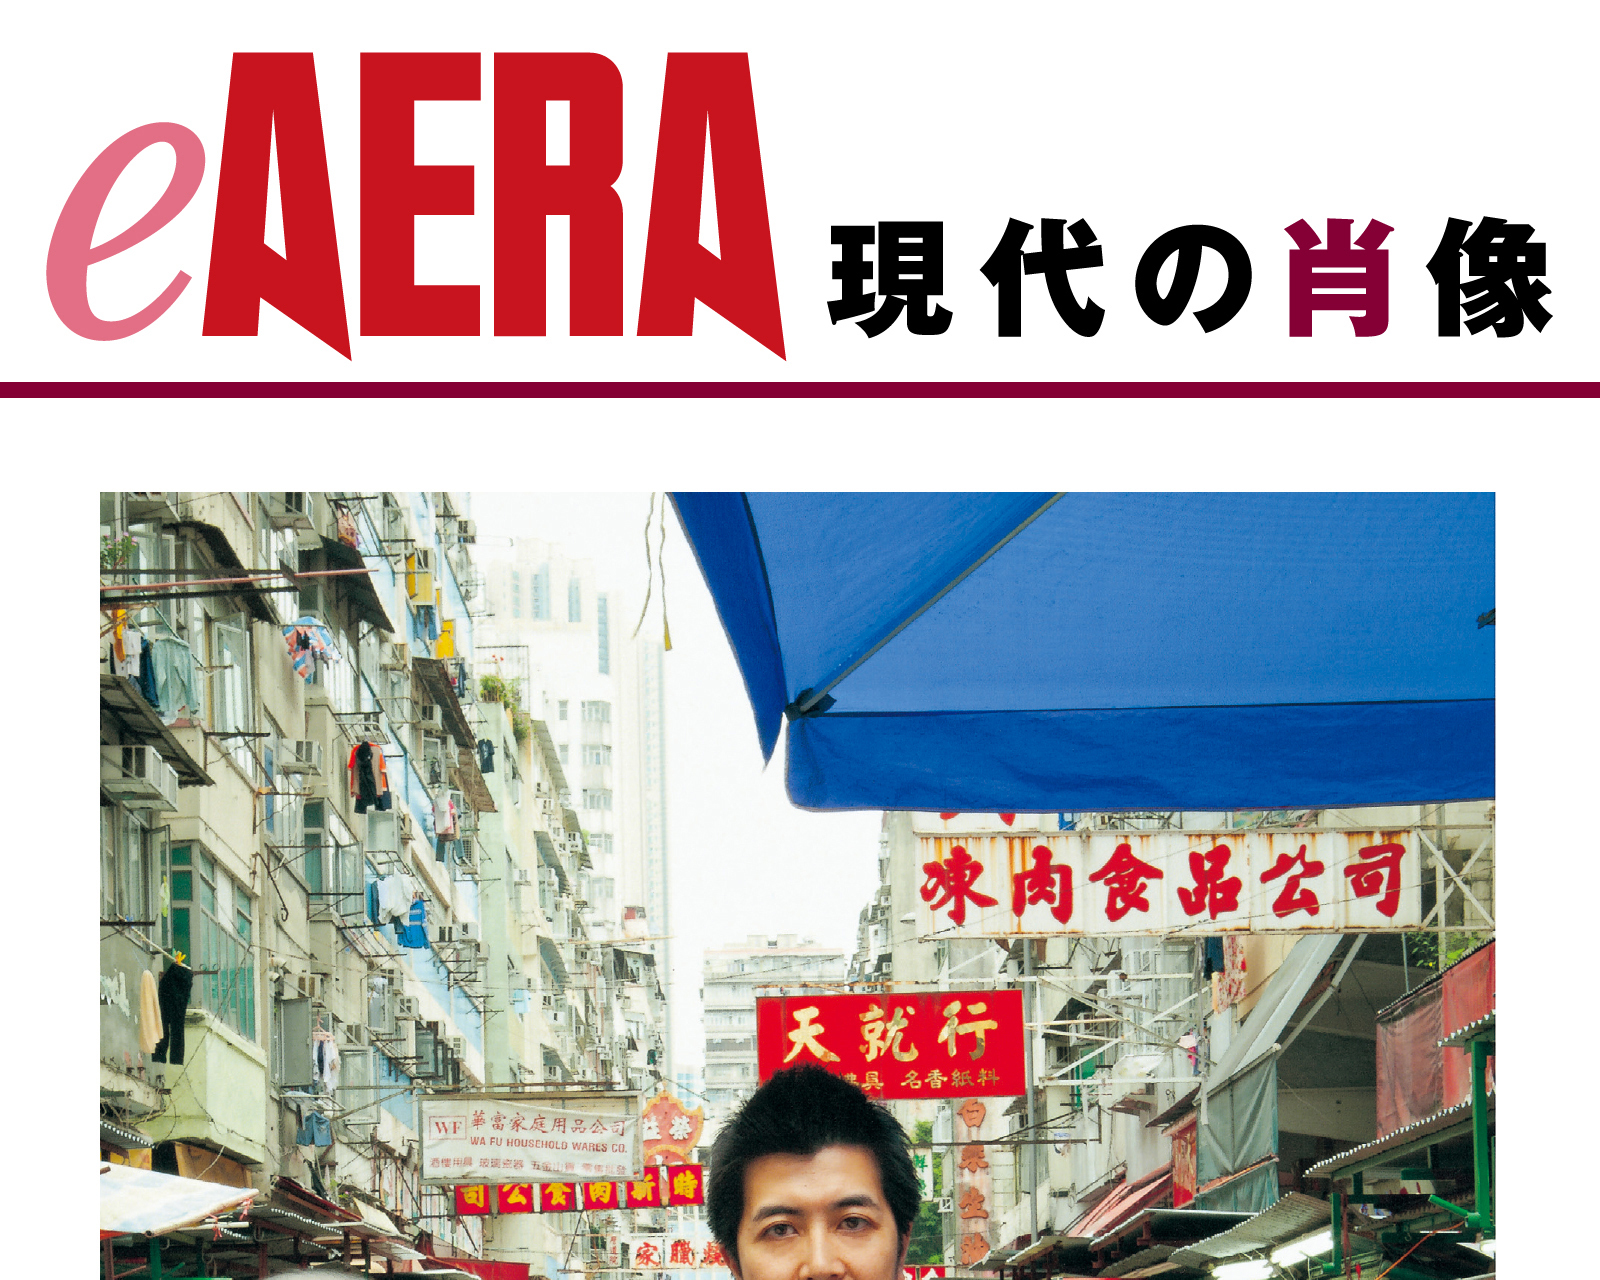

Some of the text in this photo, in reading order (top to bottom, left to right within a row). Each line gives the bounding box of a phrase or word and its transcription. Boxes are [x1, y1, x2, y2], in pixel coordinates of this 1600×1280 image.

[920, 842, 1406, 925] 凍肉食品公司
[783, 1000, 998, 1063] 天就行
[900, 1068, 1000, 1090] 名香紙料
[435, 1121, 462, 1135] WF
[471, 1110, 627, 1137] 華富家庭用品公司
[470, 1136, 628, 1154] WA FU HOUSEHOLD WARES CO.
